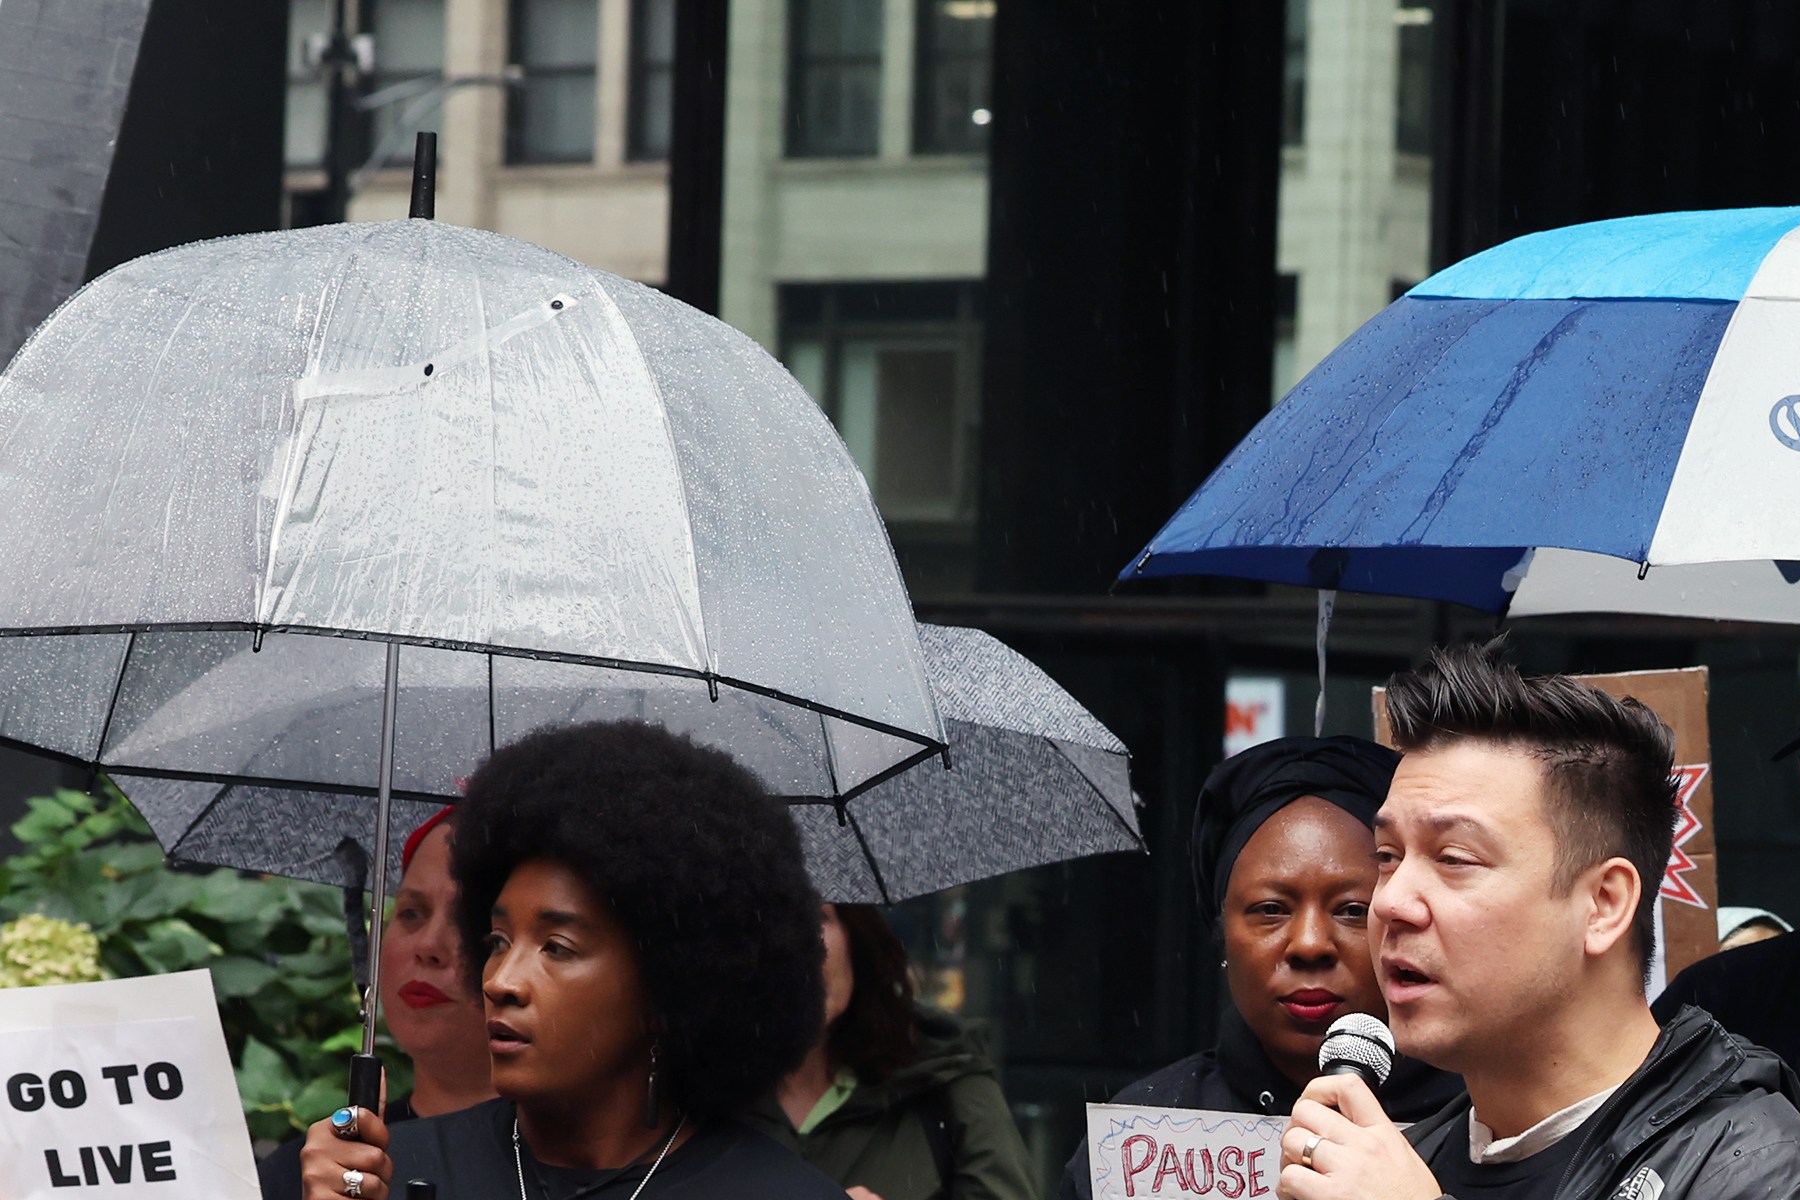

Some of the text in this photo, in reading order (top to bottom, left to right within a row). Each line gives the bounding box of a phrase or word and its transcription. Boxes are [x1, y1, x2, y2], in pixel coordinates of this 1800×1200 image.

[7, 1062, 183, 1112] GO TO
[44, 1141, 177, 1187] LIVE
[1121, 1134, 1269, 1198] PAUSE
